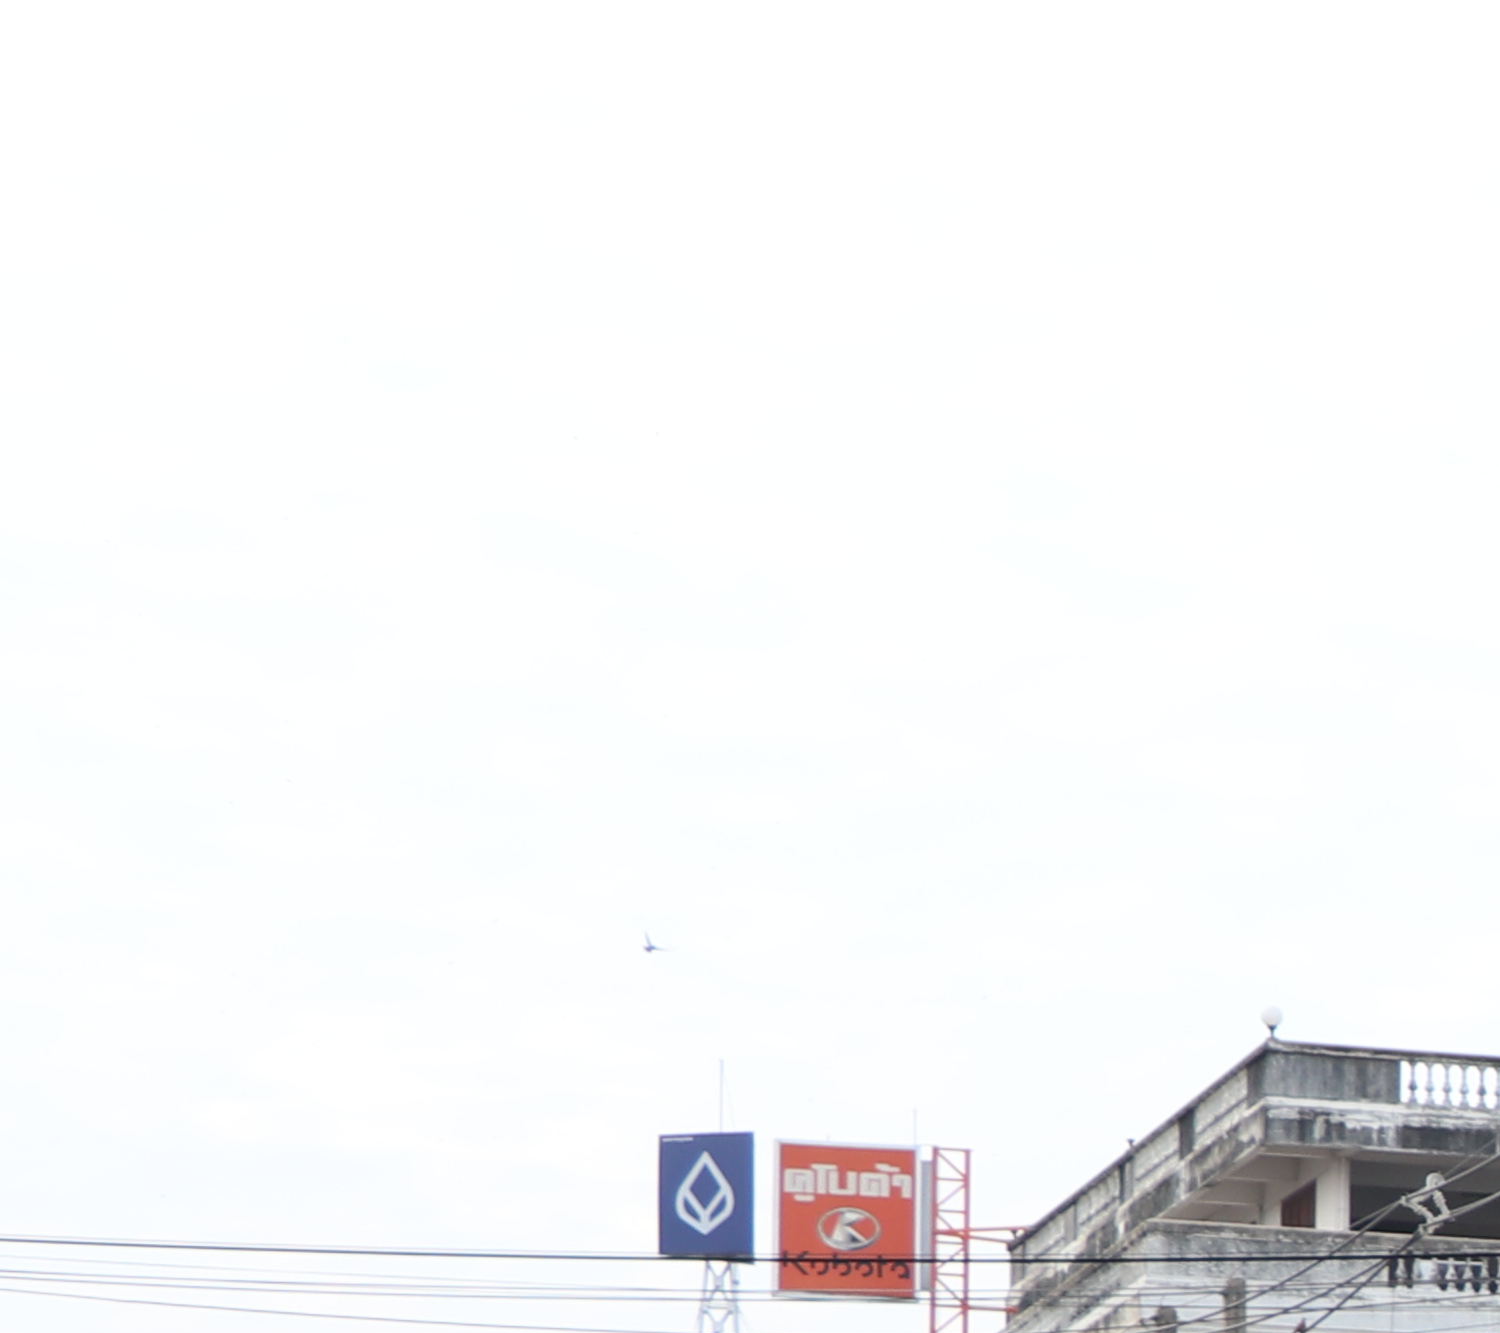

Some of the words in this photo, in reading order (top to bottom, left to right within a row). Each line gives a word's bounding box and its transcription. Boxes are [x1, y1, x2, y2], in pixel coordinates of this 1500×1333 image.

[783, 1163, 913, 1202] คูโบต้า
[782, 1250, 911, 1279] Kubota
